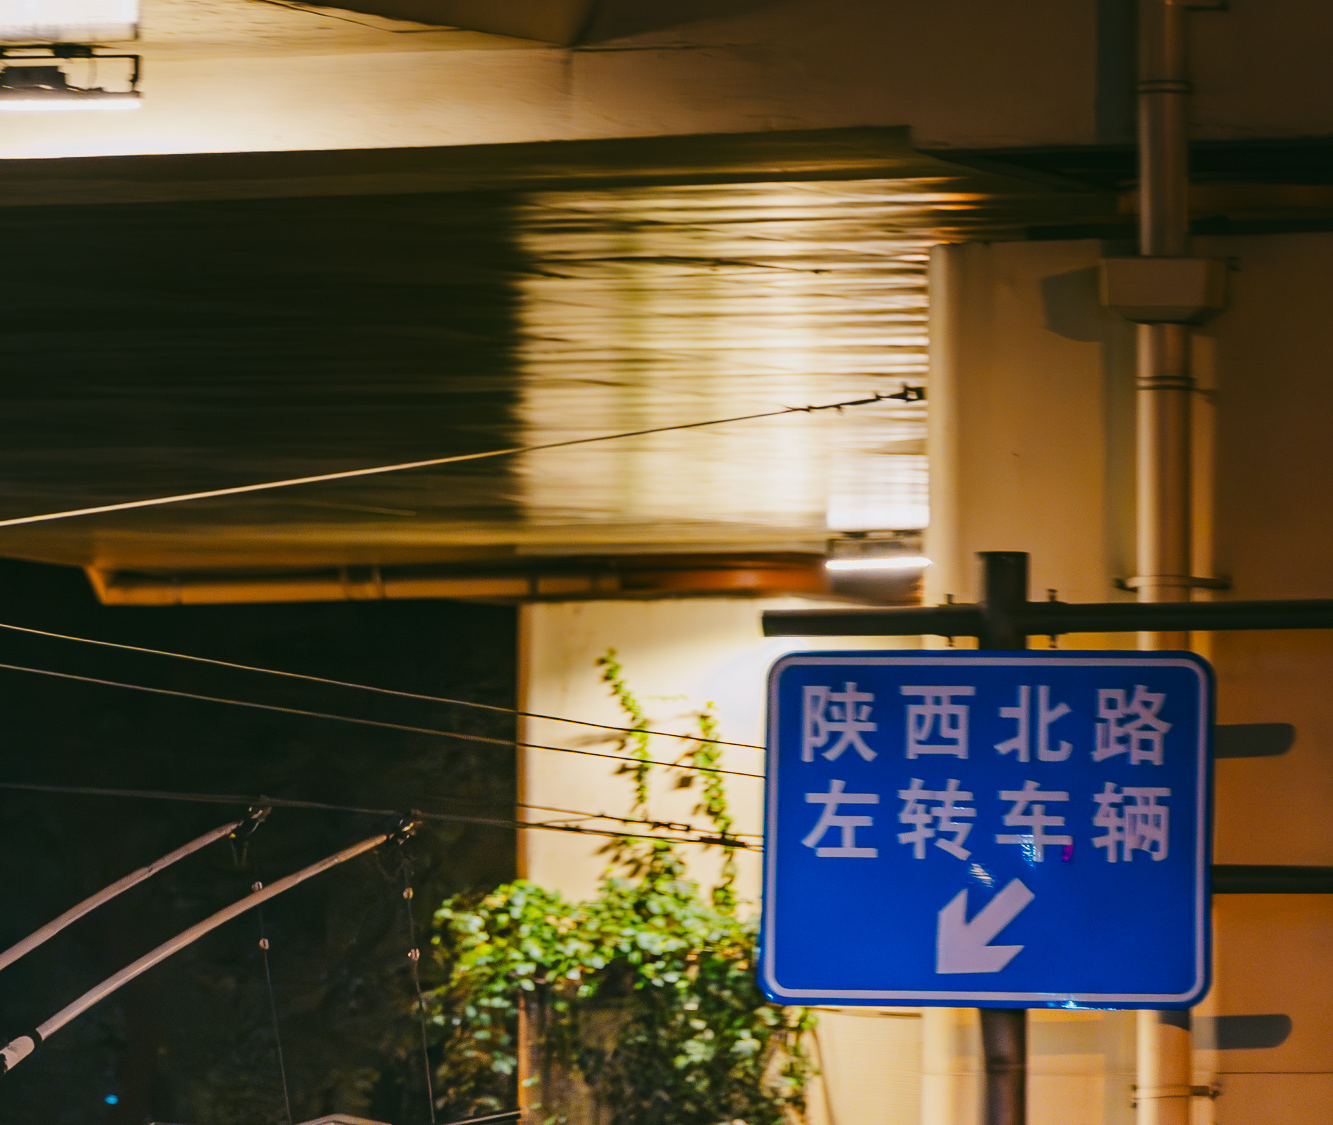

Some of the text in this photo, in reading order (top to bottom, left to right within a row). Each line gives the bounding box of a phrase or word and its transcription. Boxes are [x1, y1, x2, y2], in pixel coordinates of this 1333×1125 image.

[799, 681, 1173, 766] 陕西北路
[801, 779, 1173, 864] 左转车辆
